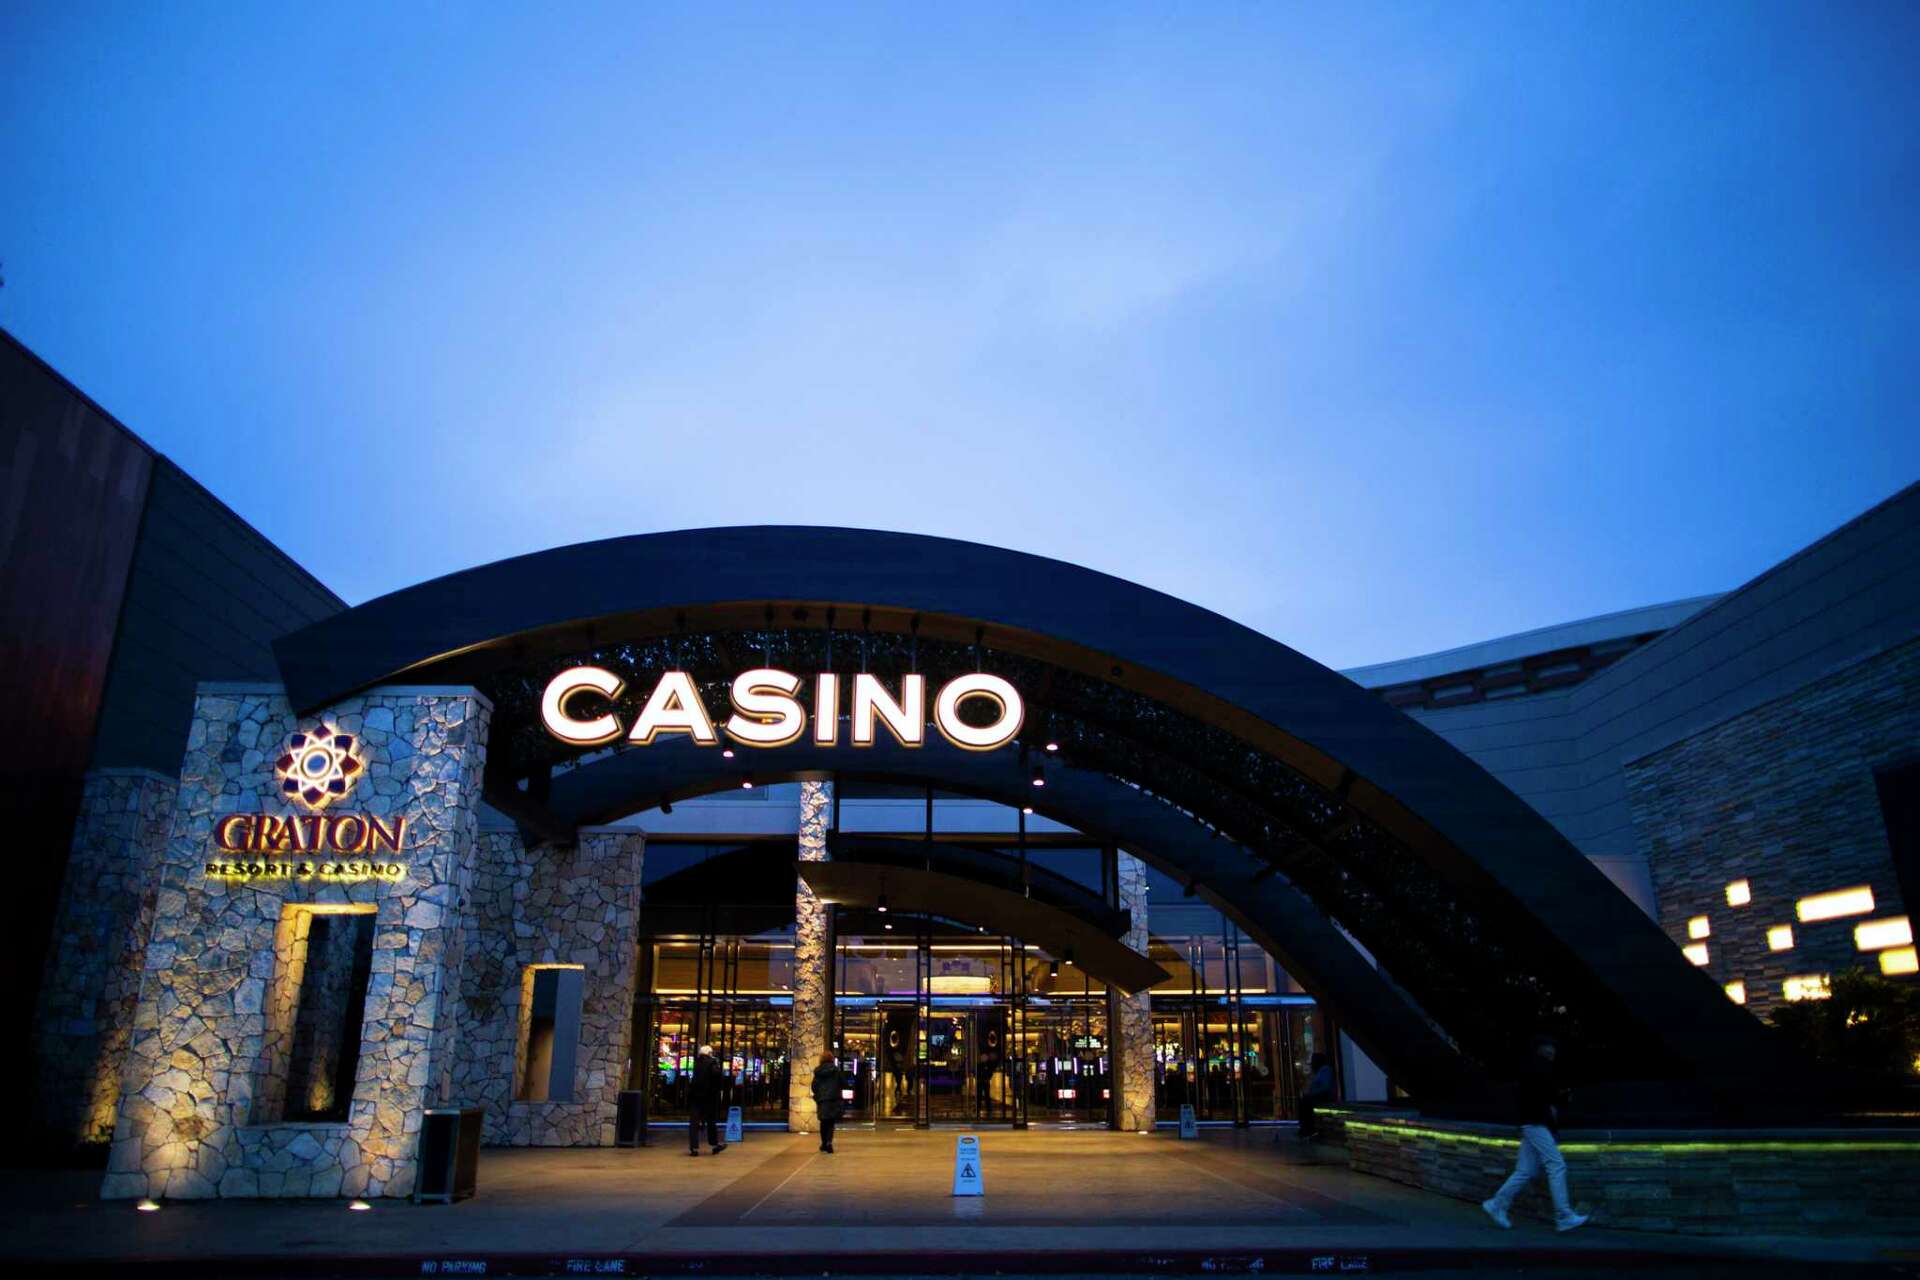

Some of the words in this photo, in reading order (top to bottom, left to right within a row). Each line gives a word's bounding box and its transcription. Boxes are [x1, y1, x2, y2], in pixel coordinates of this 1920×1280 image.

[541, 666, 1025, 750] CASINO
[214, 814, 407, 852] GRATON
[205, 862, 292, 877] RESORT
[297, 862, 313, 877] &
[319, 862, 402, 877] CASINO
[421, 1260, 438, 1273] NO
[441, 1260, 487, 1273] PARKING
[566, 1258, 591, 1272] FIRE
[594, 1258, 625, 1272] LANE
